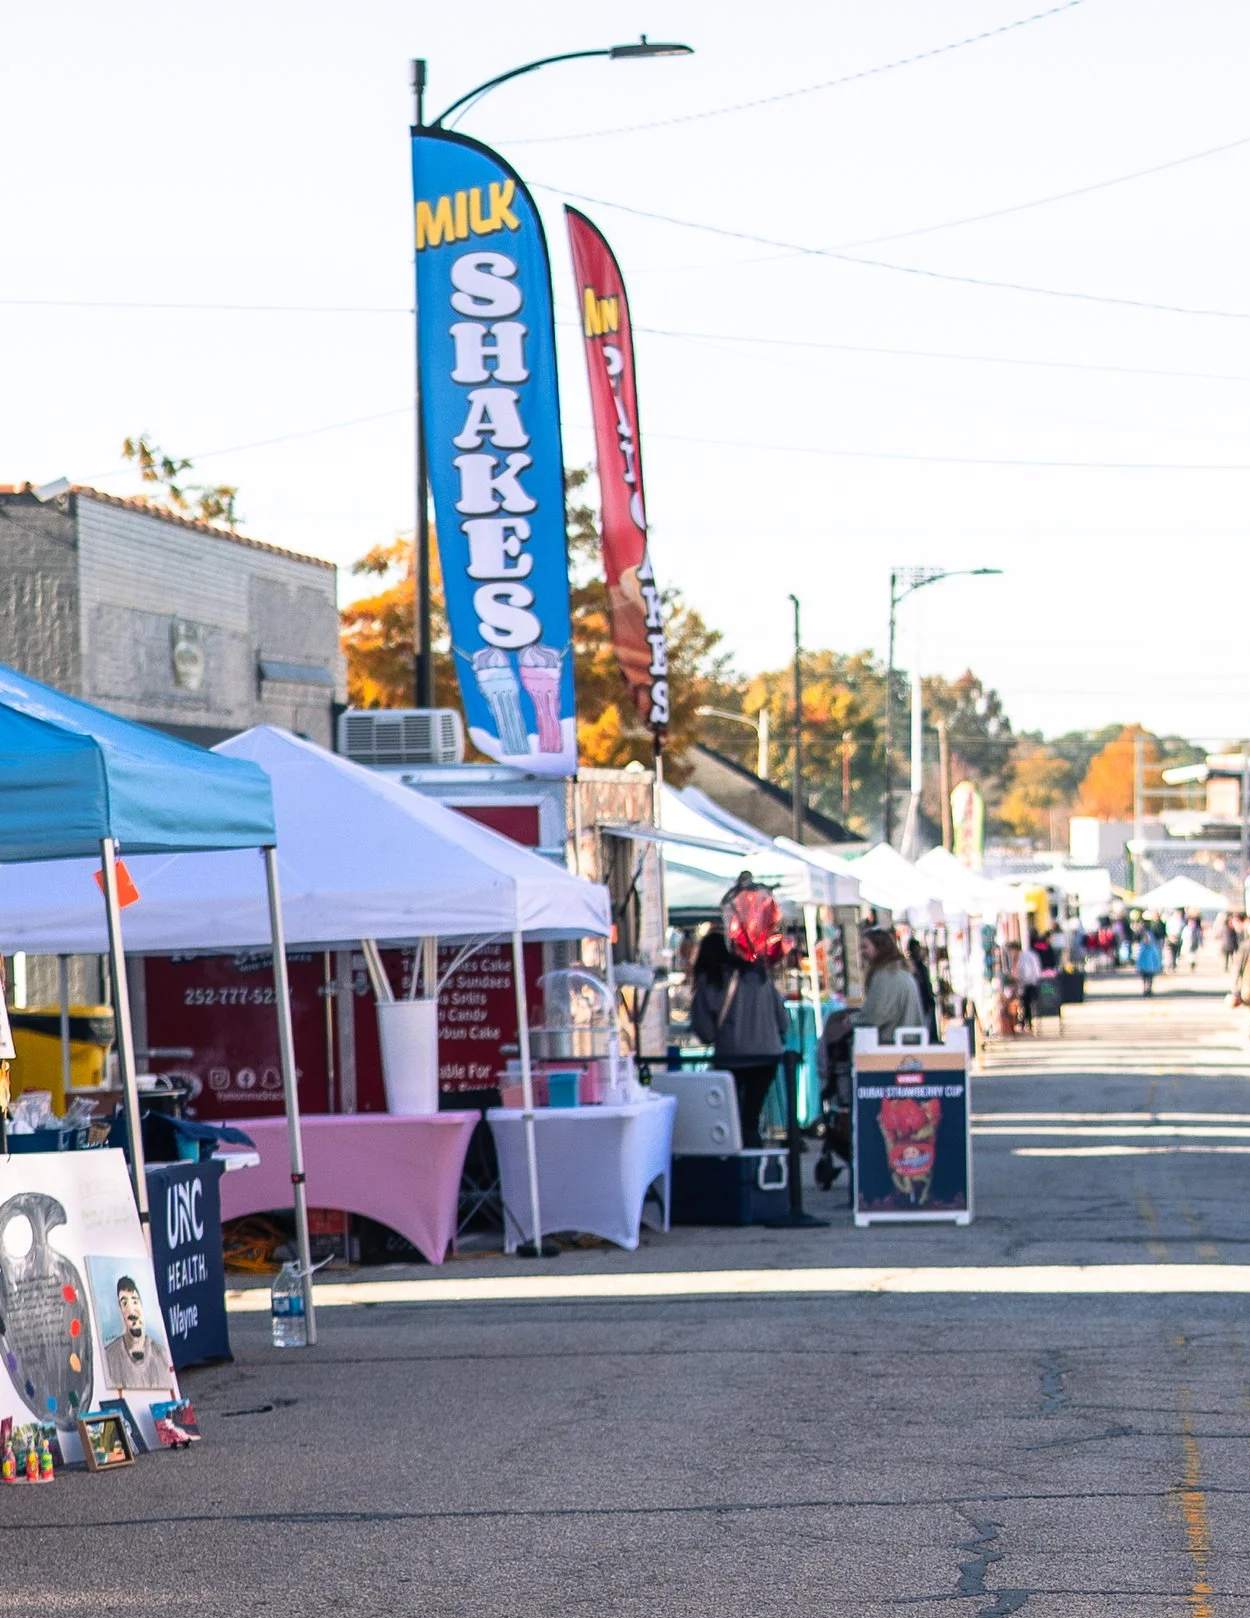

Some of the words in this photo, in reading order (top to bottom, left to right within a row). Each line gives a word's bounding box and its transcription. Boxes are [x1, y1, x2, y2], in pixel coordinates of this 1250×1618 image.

[416, 179, 520, 250] MILK
[450, 252, 542, 651] SHAKES
[184, 986, 292, 1005] 252-777-52
[167, 1177, 204, 1250] UNC
[168, 1253, 207, 1294] HEALTH
[169, 1303, 198, 1340] Wayne
